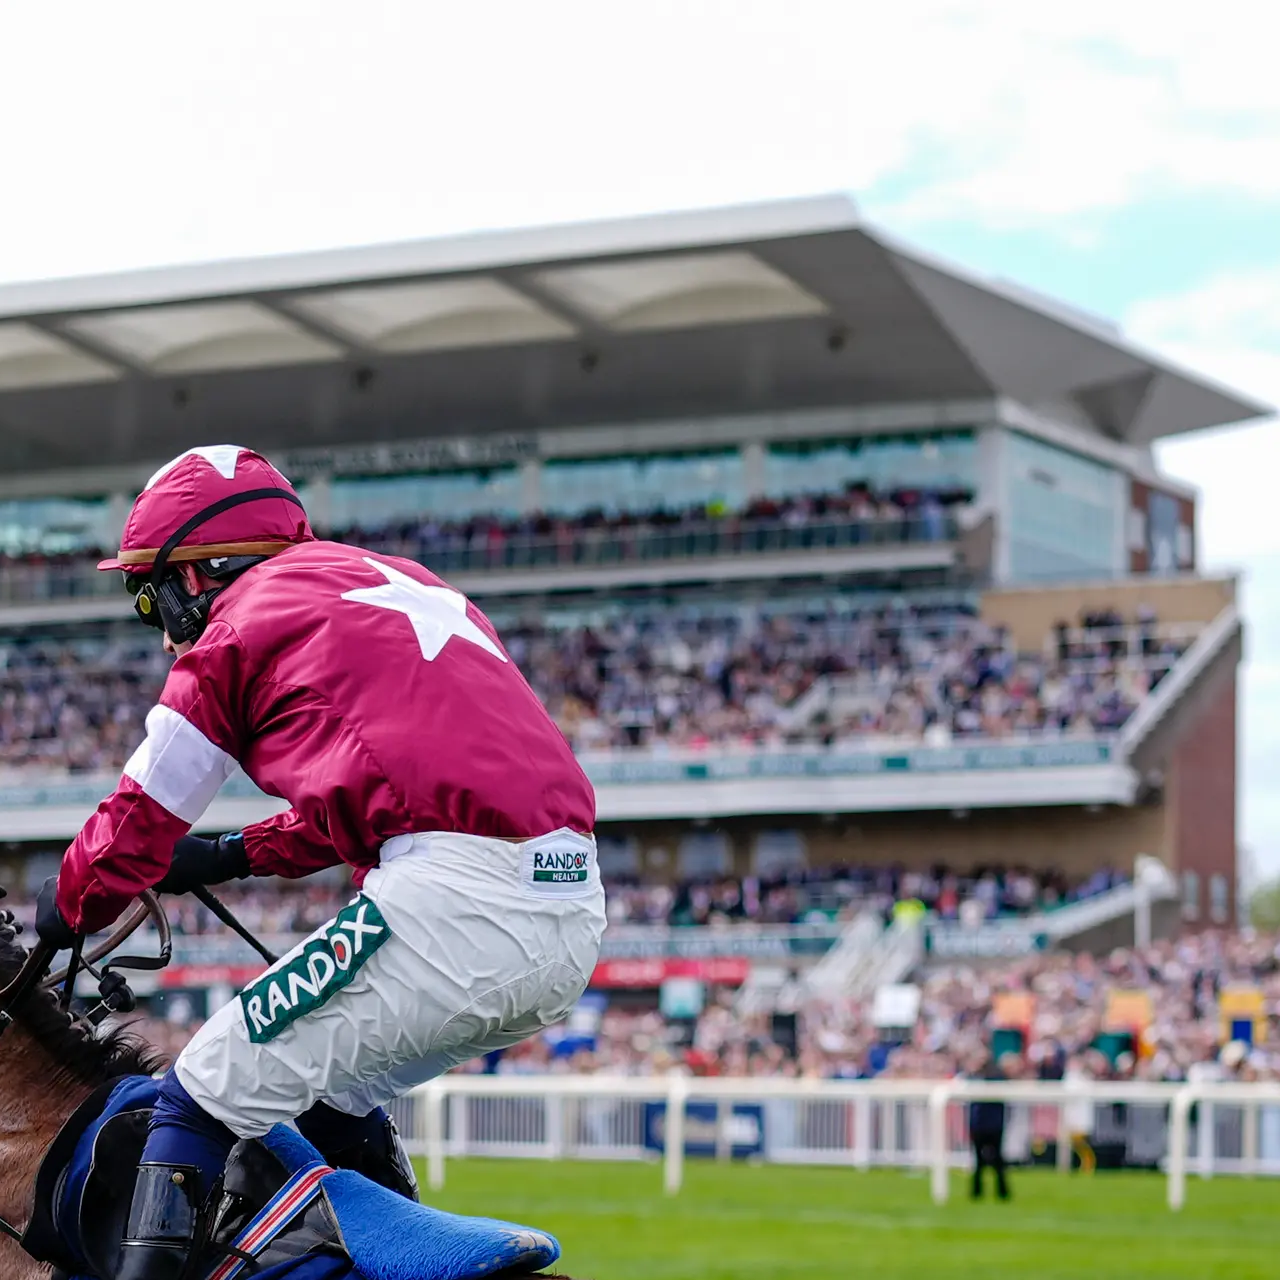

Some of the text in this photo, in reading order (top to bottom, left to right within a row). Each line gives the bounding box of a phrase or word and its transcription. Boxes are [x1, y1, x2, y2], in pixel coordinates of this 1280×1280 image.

[533, 852, 588, 869] RANDOX
[552, 872, 579, 881] HEALTH
[247, 903, 384, 1034] RANDOX
